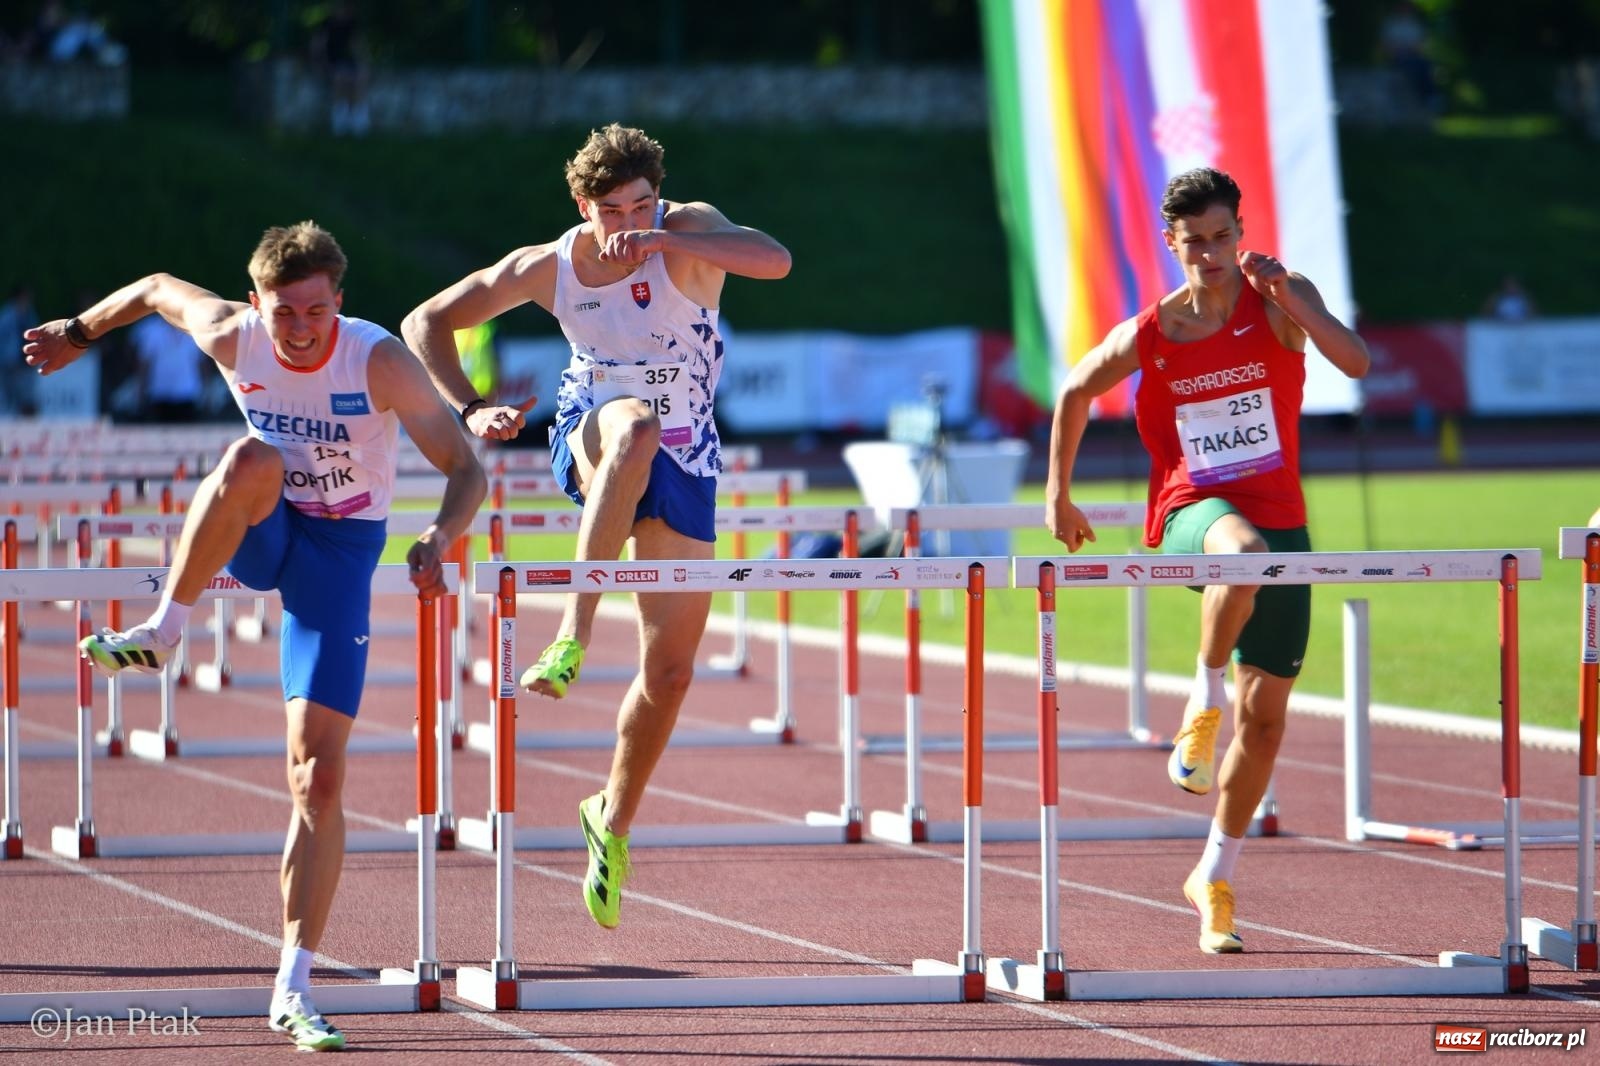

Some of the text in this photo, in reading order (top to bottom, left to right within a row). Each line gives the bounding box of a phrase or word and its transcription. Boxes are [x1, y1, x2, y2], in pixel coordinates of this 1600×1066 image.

[644, 367, 681, 385] 357
[1227, 393, 1263, 416] 253
[247, 408, 351, 442] CZECHIA
[1188, 422, 1269, 456] TAKÁCS
[616, 571, 657, 582] ORLEN
[728, 568, 753, 581] 4F
[1152, 567, 1192, 577] ORLEN
[1262, 565, 1286, 578] 4F
[1586, 604, 1598, 649] polanik
[502, 638, 514, 684] polanik
[1042, 632, 1055, 677] polanik
